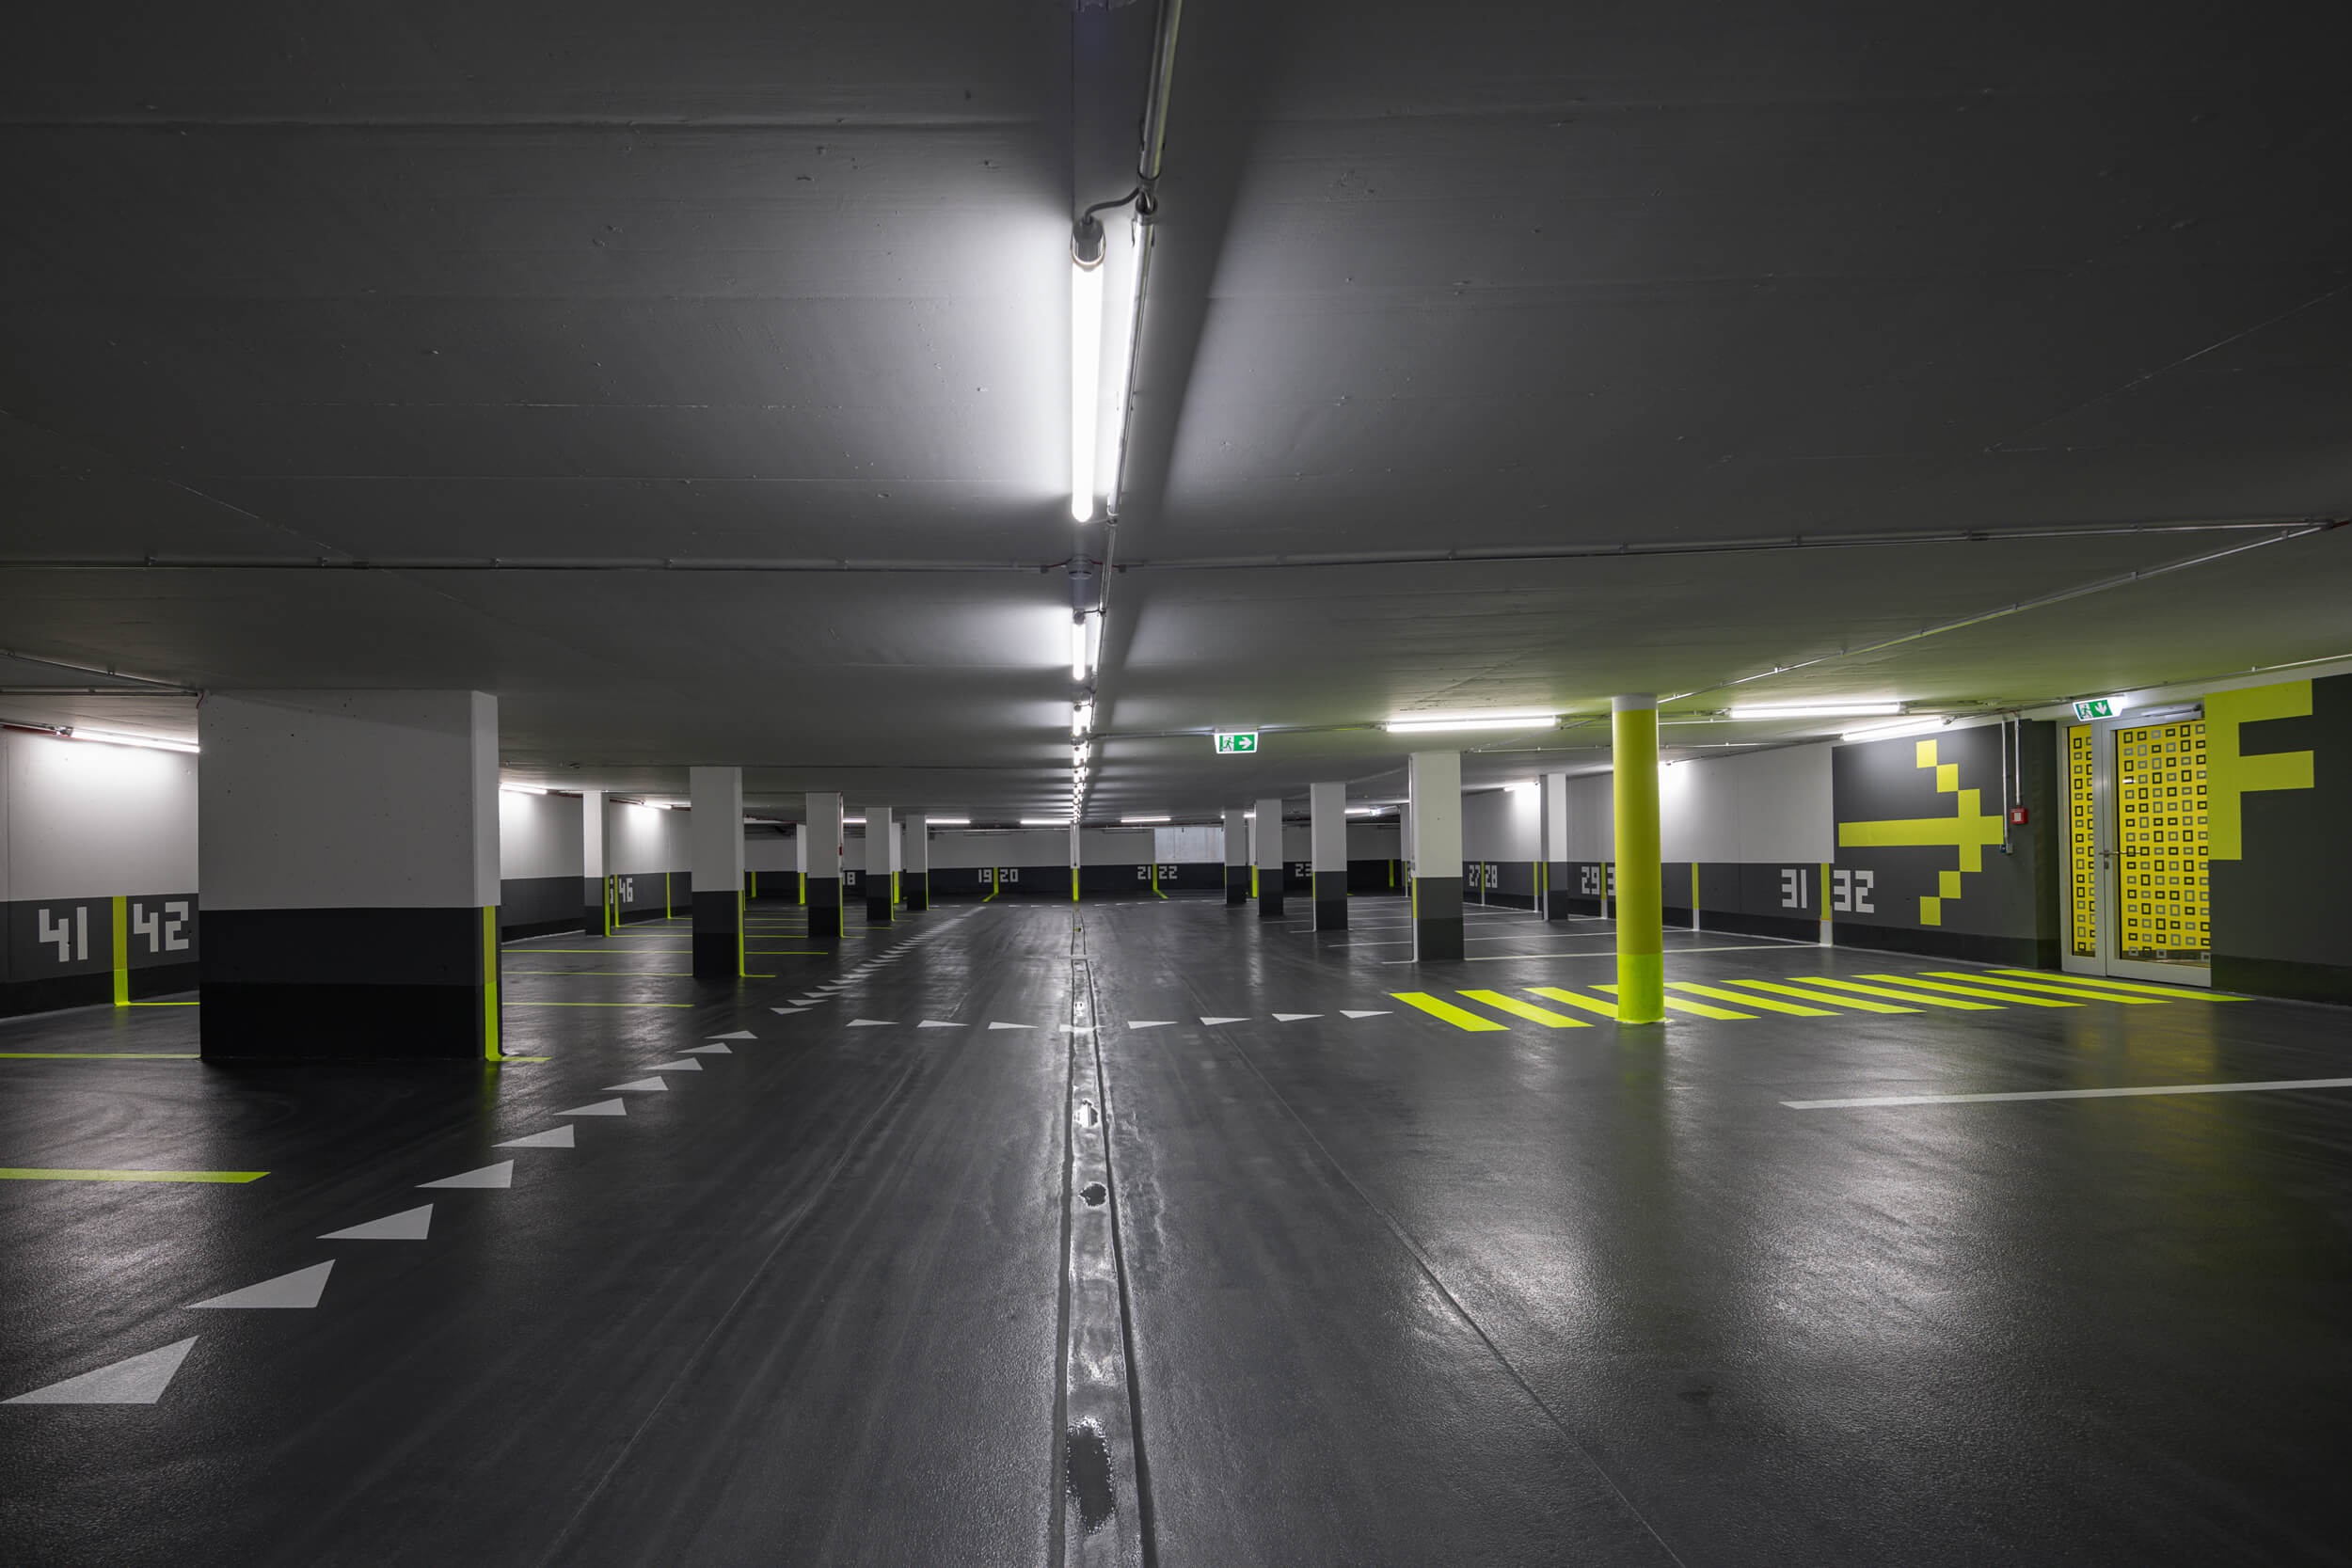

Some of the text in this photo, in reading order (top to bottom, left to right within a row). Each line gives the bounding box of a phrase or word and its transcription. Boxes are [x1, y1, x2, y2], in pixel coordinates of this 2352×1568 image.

[2204, 678, 2314, 860] F
[978, 869, 993, 882] 19
[999, 868, 1018, 882] 20
[1137, 865, 1152, 879] 21
[1158, 865, 1178, 879] 22
[1469, 864, 1480, 887] 27
[1485, 864, 1498, 888] 28
[1581, 866, 1599, 895] 29
[1607, 866, 1616, 895] 3
[618, 878, 633, 903] 46
[1781, 869, 1807, 909] 31
[1834, 870, 1875, 913] 32
[39, 906, 88, 962] 41
[134, 901, 189, 953] 42
